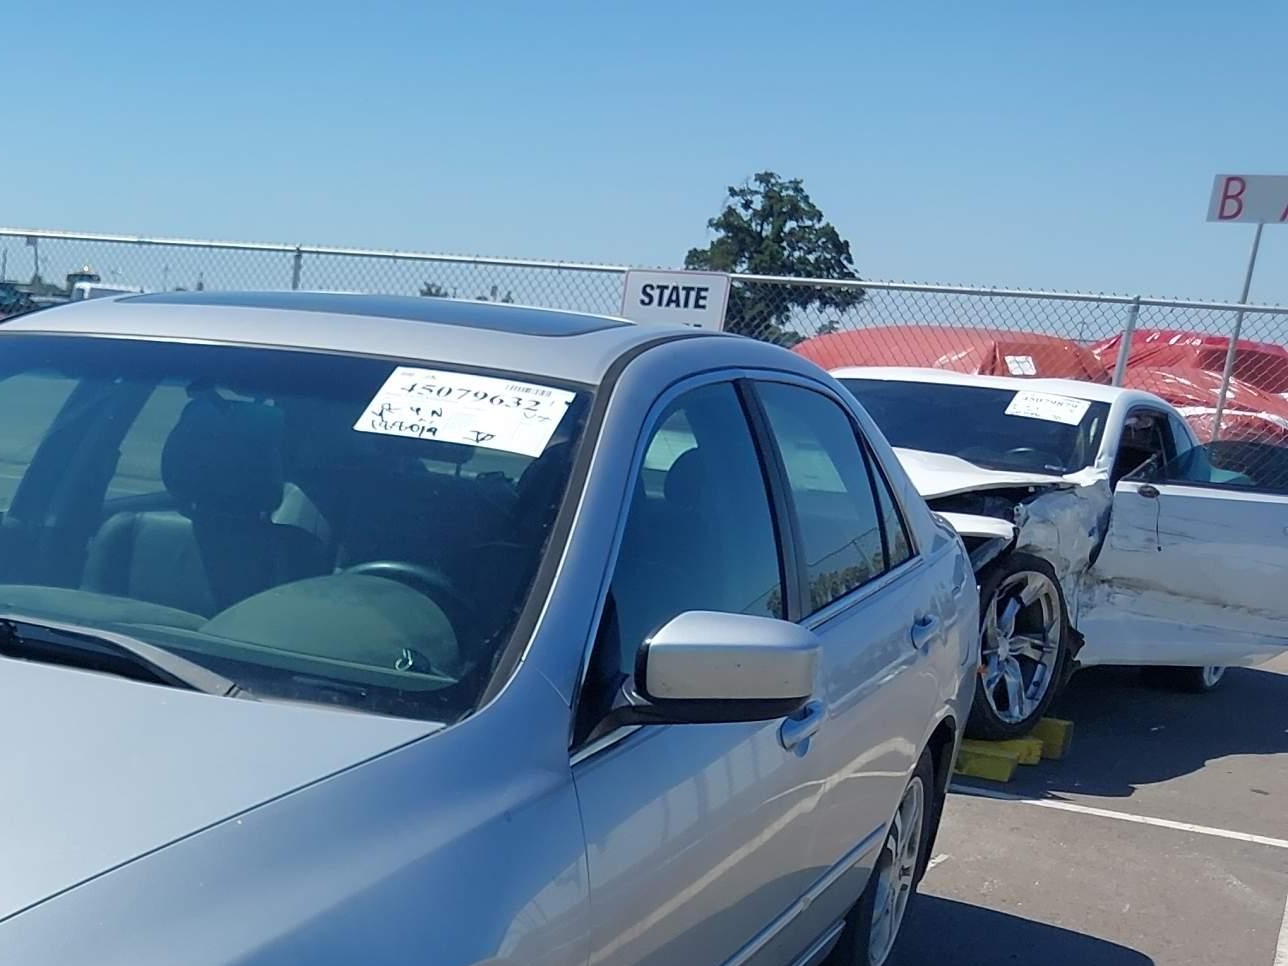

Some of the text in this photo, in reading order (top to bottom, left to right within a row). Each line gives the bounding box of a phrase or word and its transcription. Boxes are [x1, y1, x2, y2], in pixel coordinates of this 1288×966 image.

[1218, 176, 1246, 220] B
[639, 283, 709, 310] STATE
[400, 382, 542, 412] 45079632
